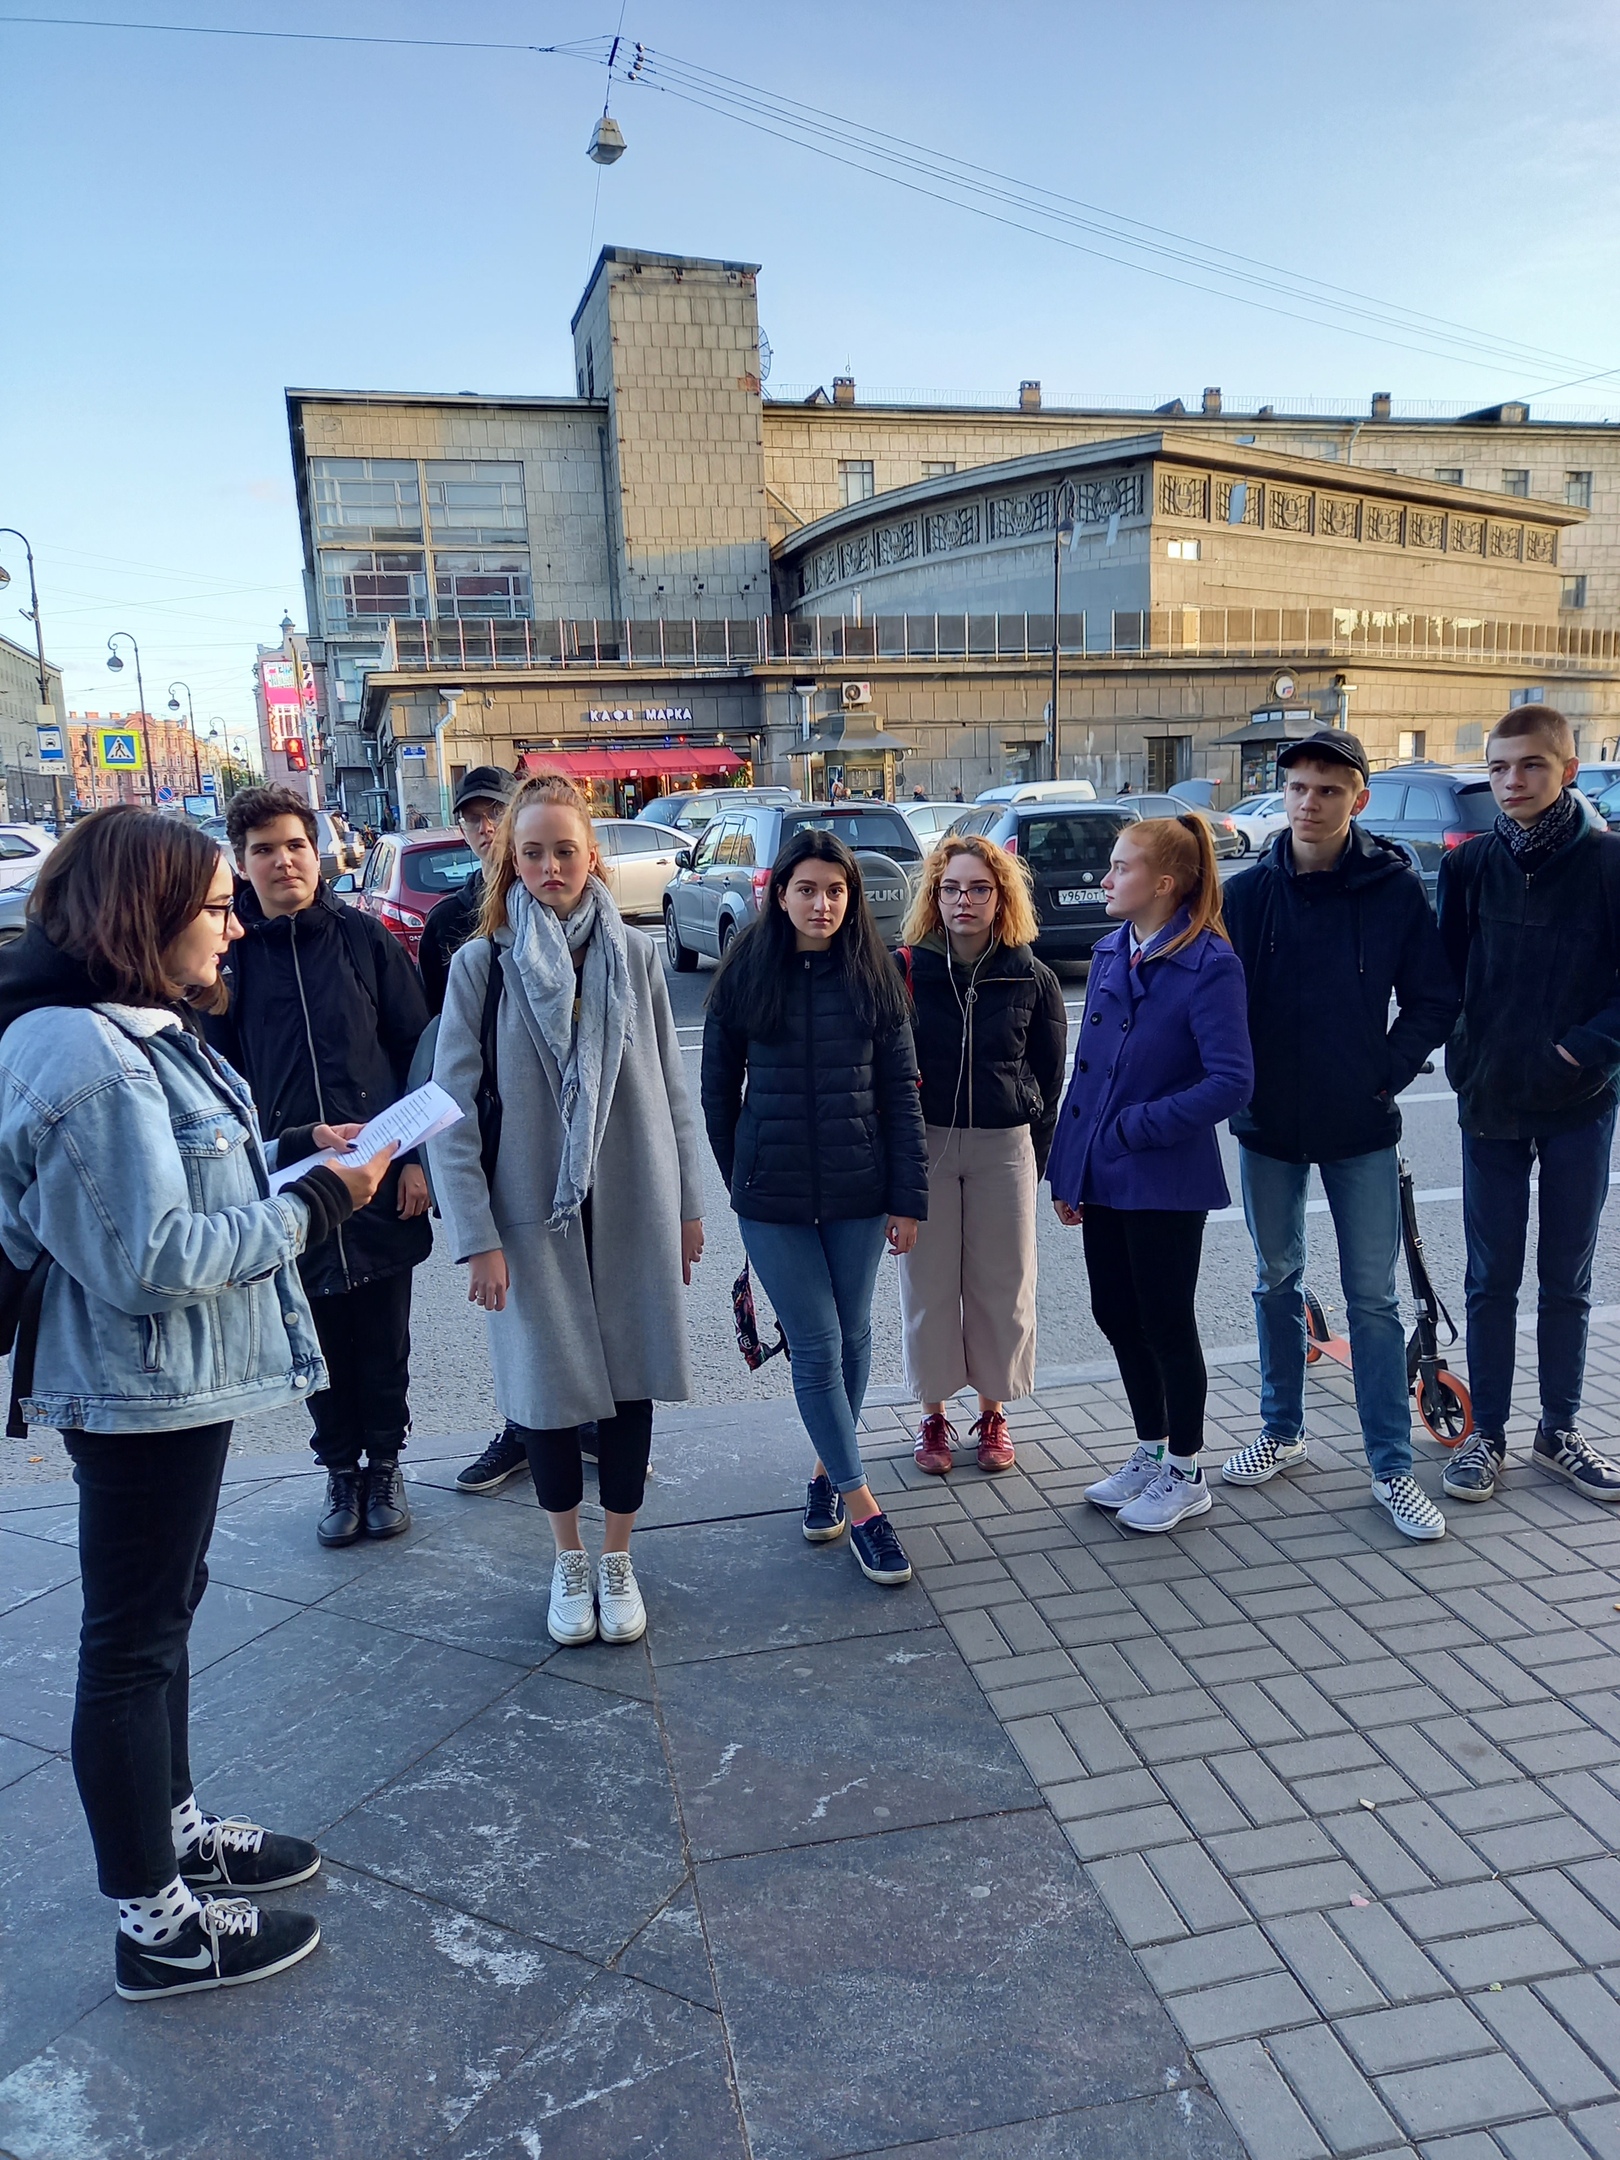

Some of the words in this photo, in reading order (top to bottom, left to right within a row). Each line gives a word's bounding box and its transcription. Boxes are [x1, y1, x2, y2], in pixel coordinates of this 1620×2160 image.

[590, 709, 634, 722] КАФЕ
[645, 708, 692, 721] МАРКА
[864, 888, 904, 901] ZUKI
